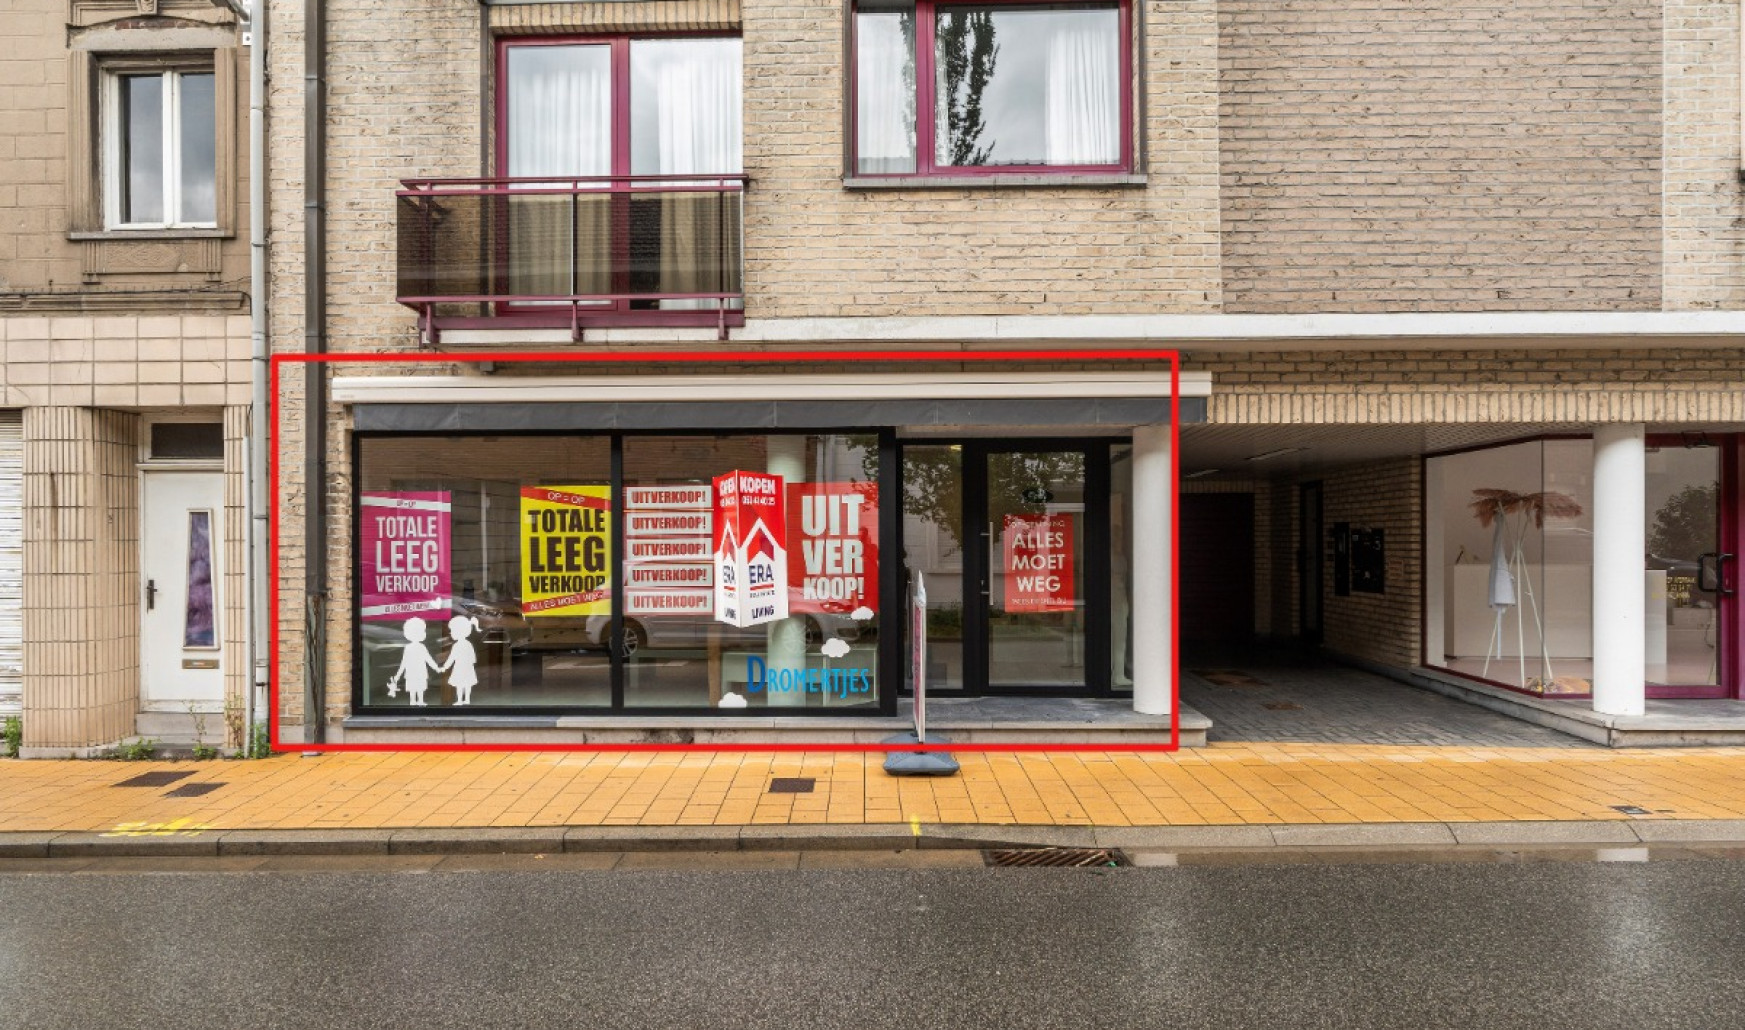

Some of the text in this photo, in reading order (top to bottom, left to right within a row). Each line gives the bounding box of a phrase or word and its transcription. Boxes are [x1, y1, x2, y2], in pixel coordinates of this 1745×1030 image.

[739, 476, 776, 495] KOPEN
[547, 491, 562, 501] OP
[571, 495, 585, 504] OP
[631, 491, 706, 504] UITVERKOOP!
[527, 509, 606, 532] TOTALE
[632, 516, 706, 530] UITVERKOOP!
[802, 494, 865, 536] UIT
[375, 516, 437, 539] TOTALE
[632, 543, 706, 556] UITVERKOOP!
[1011, 532, 1065, 549] ALLES
[376, 540, 439, 574] LEEG
[529, 535, 606, 573] LEEG
[802, 538, 865, 575] VER
[1011, 554, 1066, 571] MOET
[632, 569, 707, 582] UITVERKOOP!
[748, 563, 774, 584] ERA
[375, 576, 439, 593] VERKOOP
[529, 575, 606, 593] VERKOOP
[803, 577, 865, 600] KOOP!
[1017, 575, 1061, 593] WEG
[530, 601, 556, 611] ALLES
[557, 596, 581, 607] MOET
[633, 595, 708, 609] UITVERKOOP!
[747, 655, 869, 699] DROMERTJES
